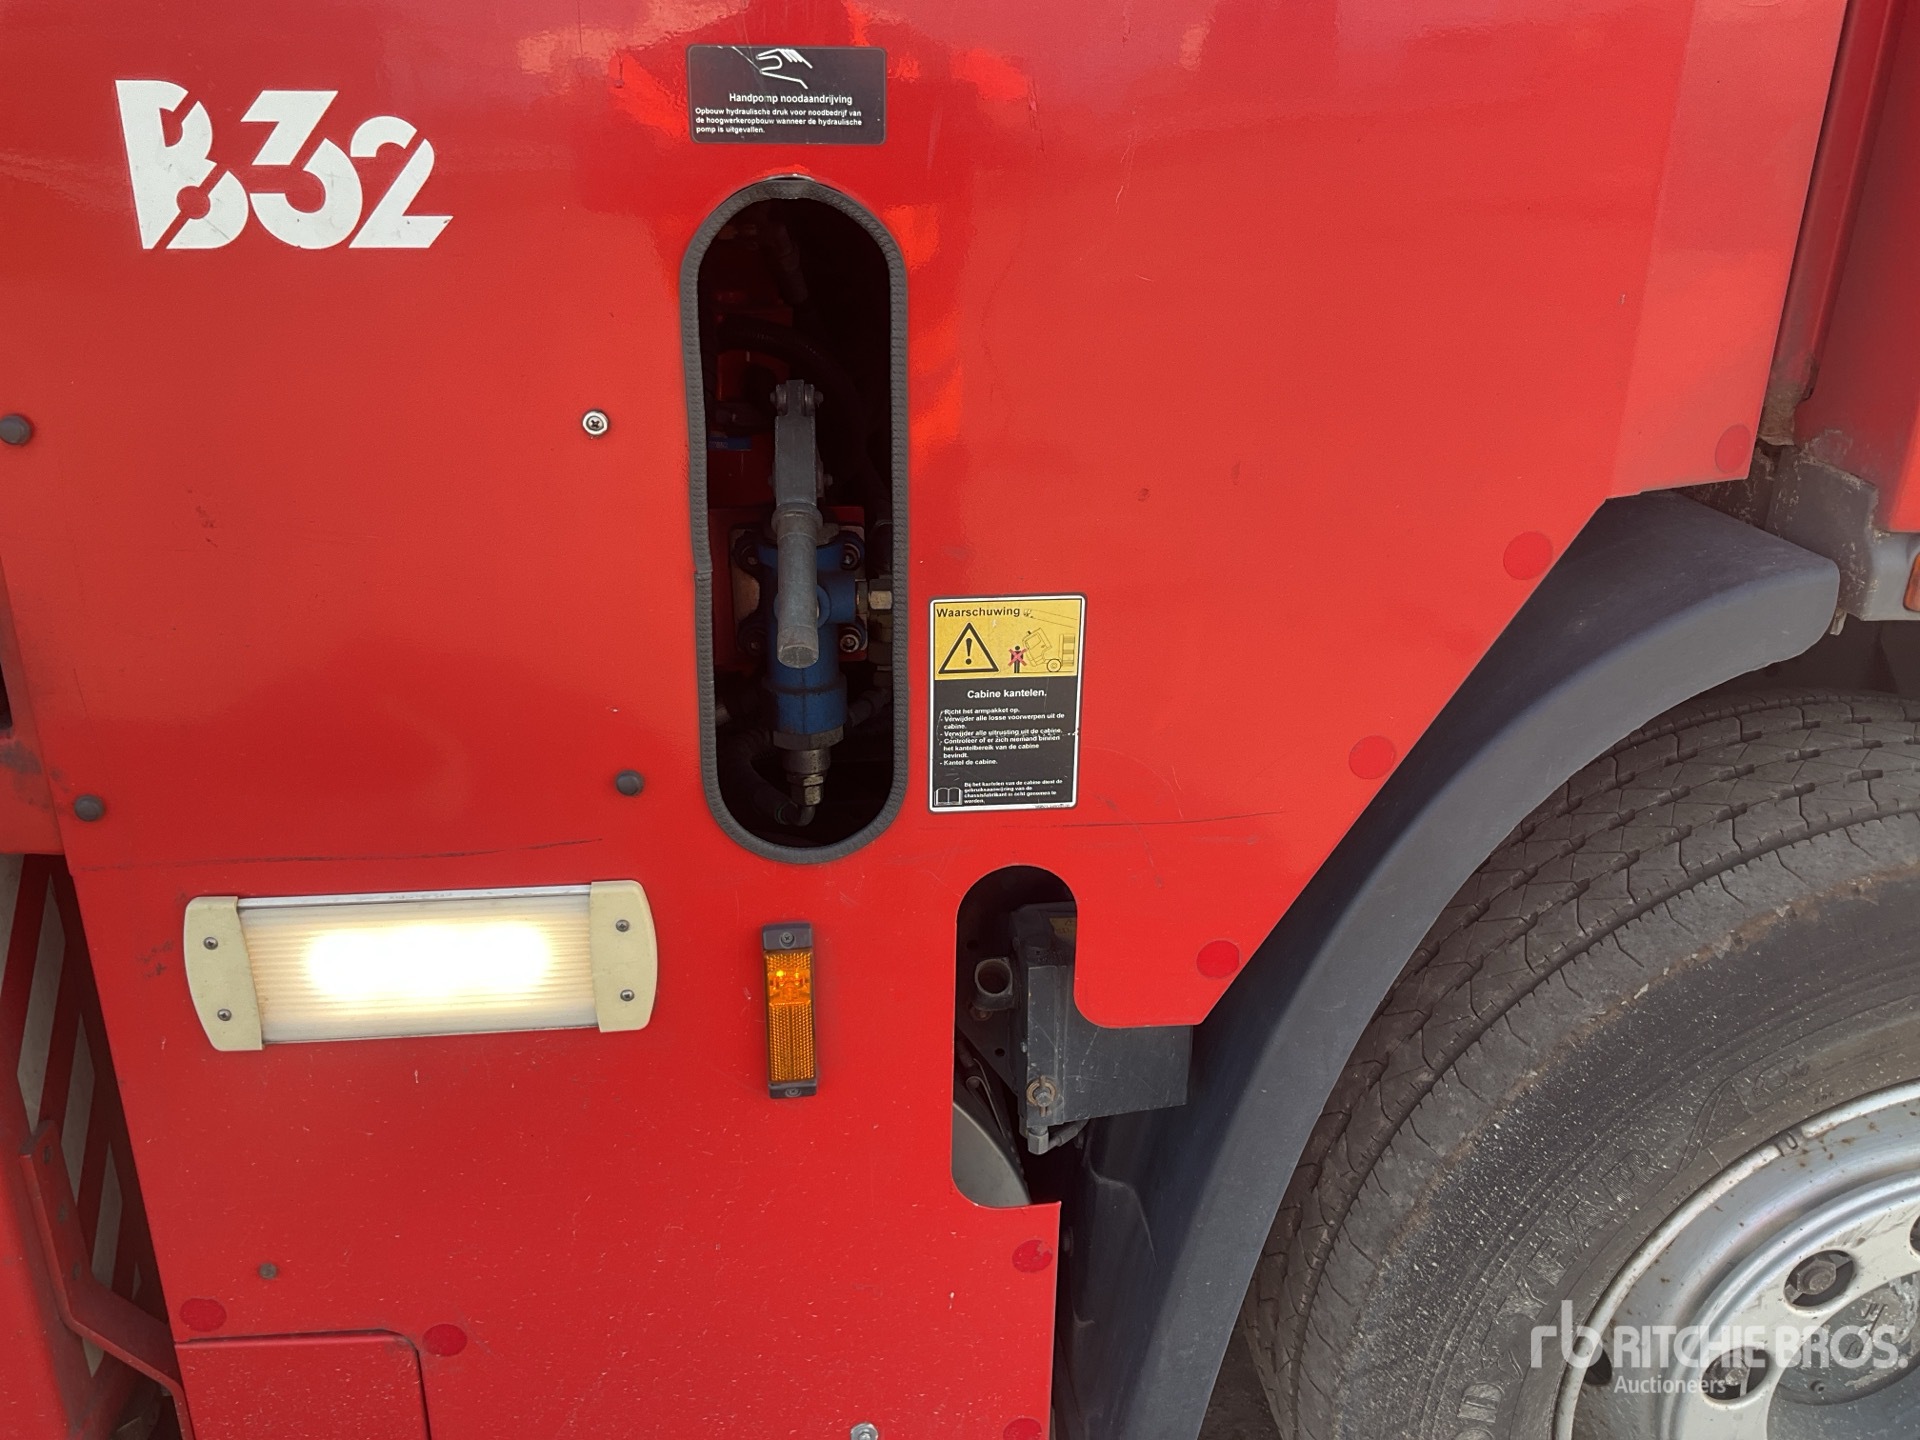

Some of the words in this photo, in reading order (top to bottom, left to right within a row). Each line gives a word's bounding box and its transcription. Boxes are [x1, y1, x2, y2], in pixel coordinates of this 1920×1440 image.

[729, 93, 778, 104] Handpomp
[781, 93, 853, 105] noodaandrijving
[726, 108, 770, 117] hydraulische
[808, 108, 848, 118] noodbedrijf
[706, 117, 774, 126] hoogwerkeropbouw
[818, 118, 862, 127] hydraulische
[115, 80, 453, 249] B32
[936, 606, 1020, 617] Waarschuwing
[967, 690, 1001, 699] Cabine
[1003, 689, 1048, 698] kantelen.
[1007, 713, 1045, 721] voorwerpen
[944, 730, 974, 738] Verwijder
